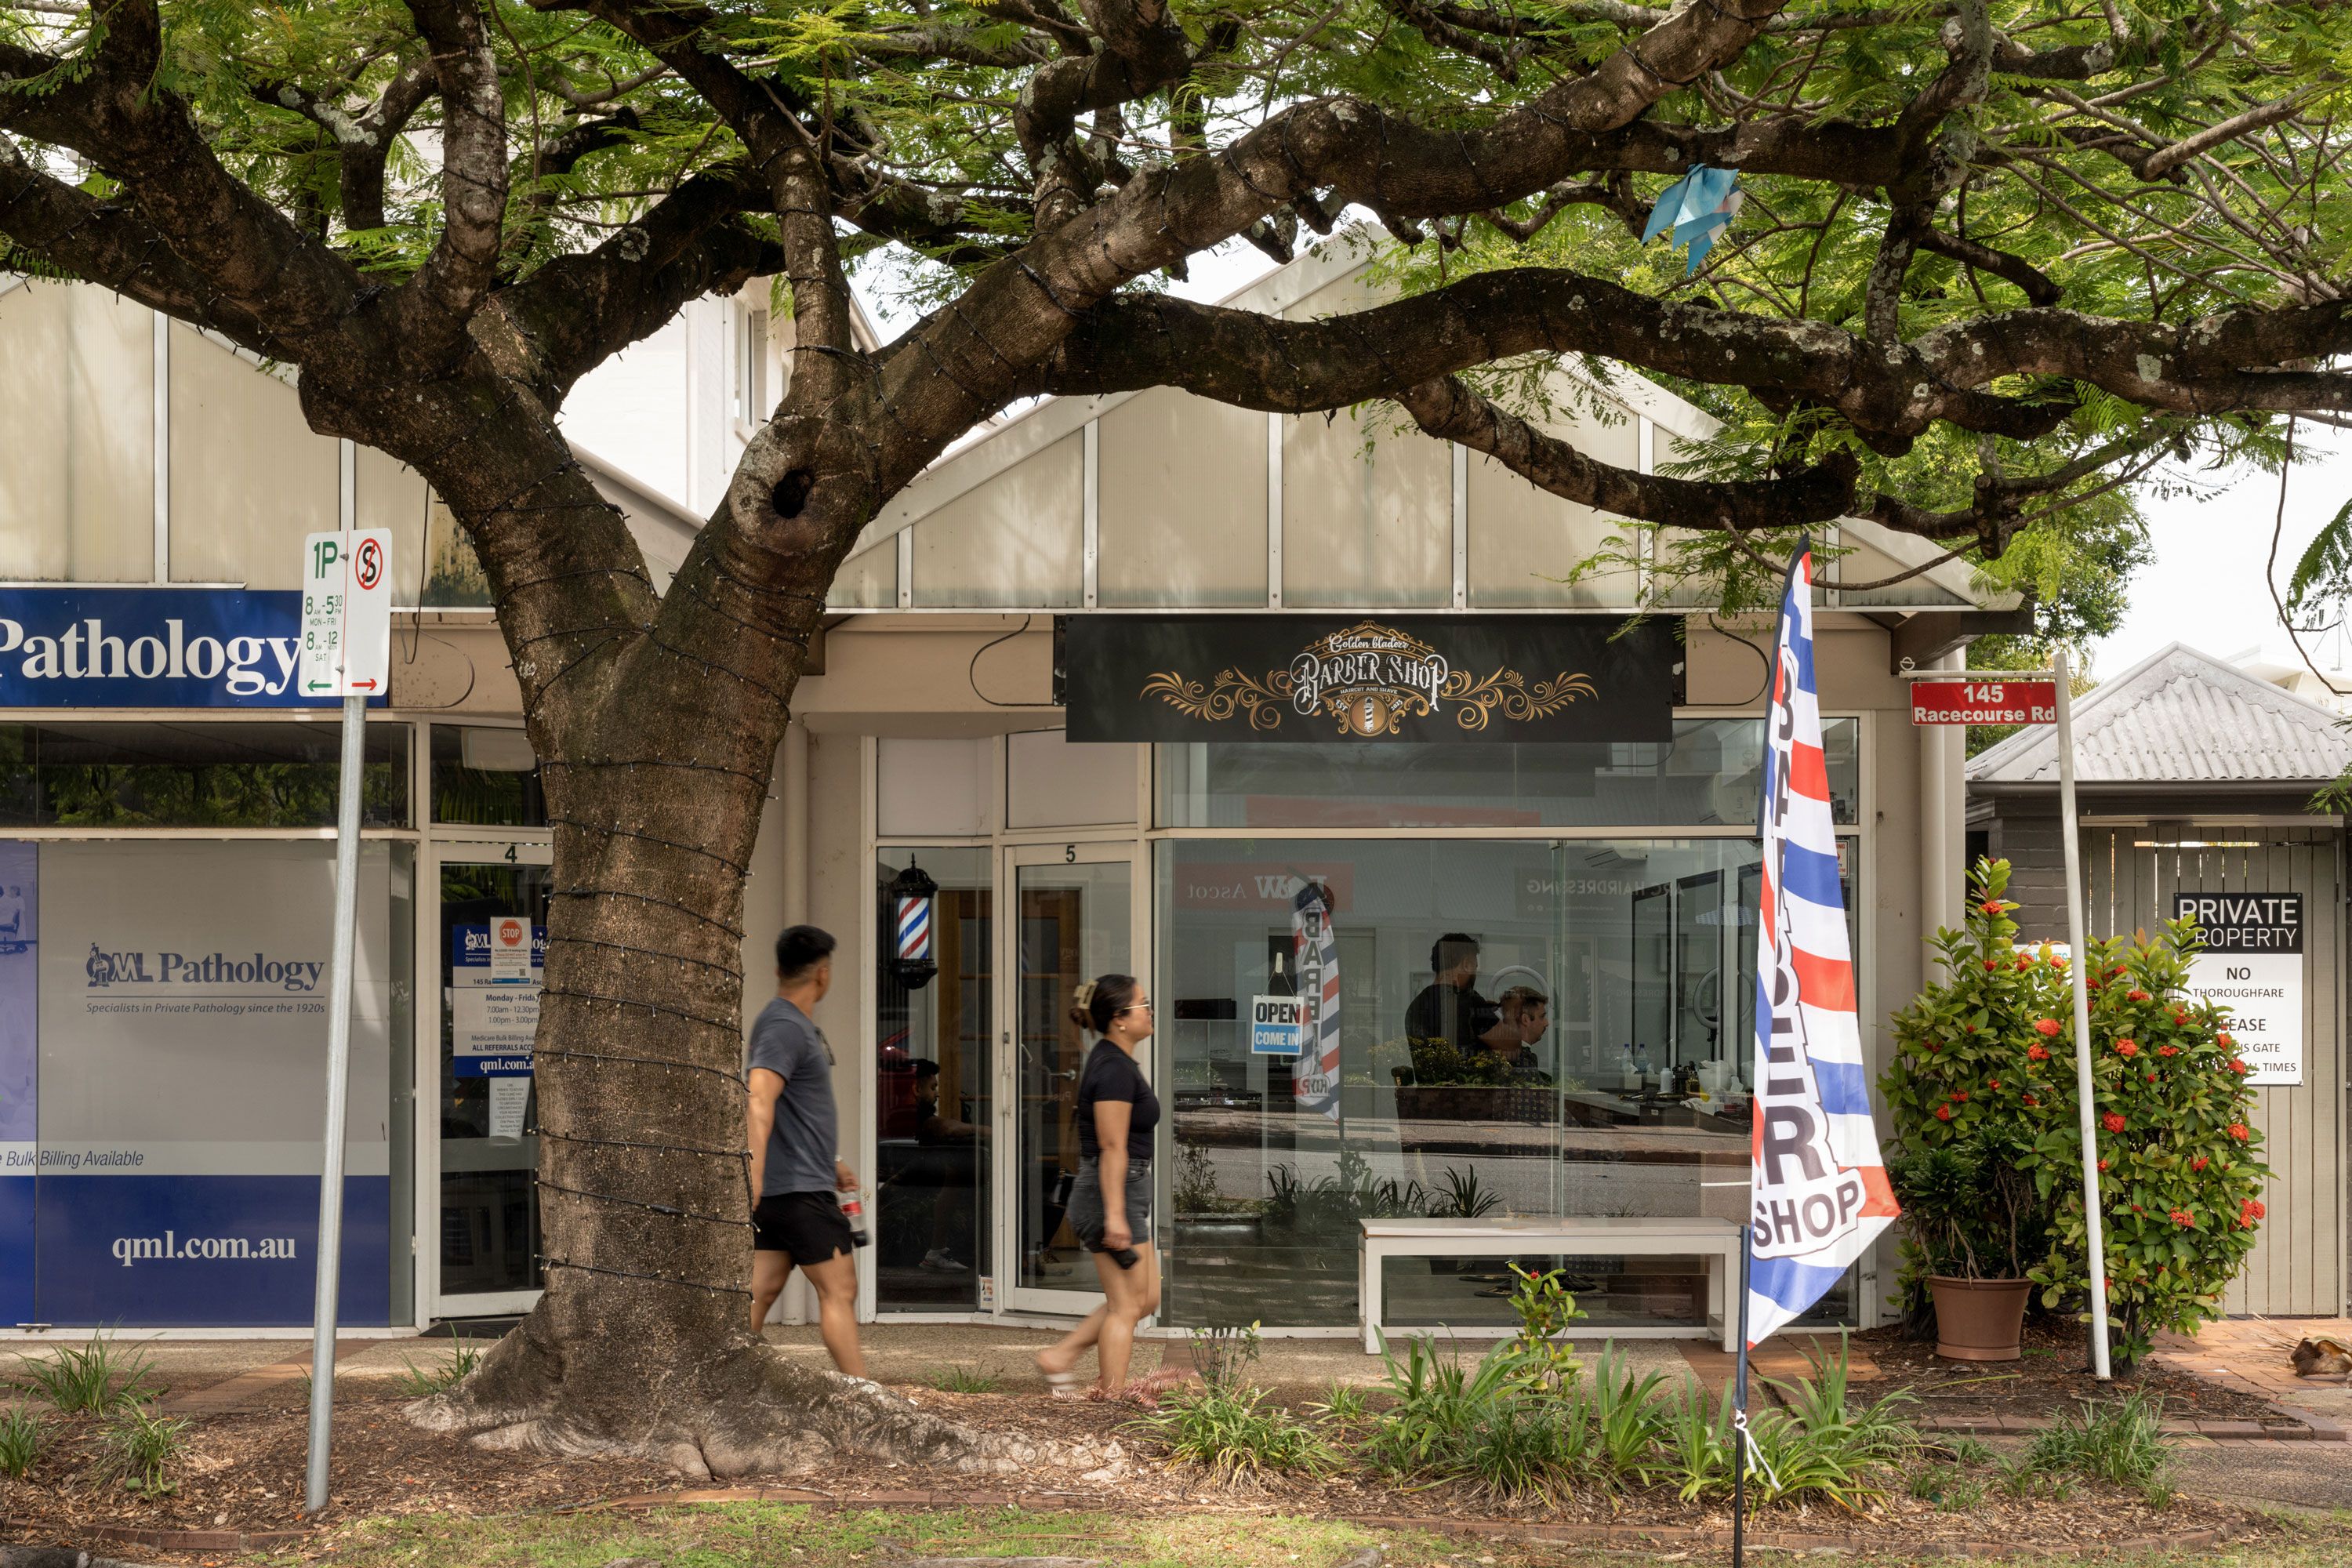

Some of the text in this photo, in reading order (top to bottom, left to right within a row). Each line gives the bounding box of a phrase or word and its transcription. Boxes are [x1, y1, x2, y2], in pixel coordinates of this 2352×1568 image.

[314, 541, 338, 579] 1P
[1329, 635, 1370, 652] Golden
[1290, 652, 1448, 714] BARBER SHOP
[1963, 684, 2004, 703] 145
[1335, 699, 1348, 711] EST
[1914, 706, 2056, 722] Racecourse Rd
[505, 845, 517, 863] 4
[1066, 845, 1076, 862] 5
[2180, 898, 2298, 924] PRIVATE
[502, 928, 520, 938] STOP
[2187, 927, 2297, 947] ROPERTY
[86, 944, 325, 992] QML Pathology
[2227, 967, 2251, 980] NO
[486, 994, 514, 1003] Monday
[2193, 988, 2285, 998] THOROUGHFARE
[86, 1003, 325, 1015] Specialists in Private Pathology since the 1920s
[1255, 1002, 1301, 1024] OPEN
[508, 1034, 524, 1043] Billing
[1254, 1030, 1300, 1046] COME IN
[2252, 1044, 2281, 1053] GATE
[480, 1058, 535, 1074] qml.com.a
[2263, 1062, 2297, 1072] TIMES
[6, 1151, 36, 1167] Bulk
[40, 1150, 80, 1169] Billing
[83, 1150, 143, 1167] Available
[1754, 1179, 1859, 1248] SHOP
[112, 1230, 296, 1267] qml.com.au
